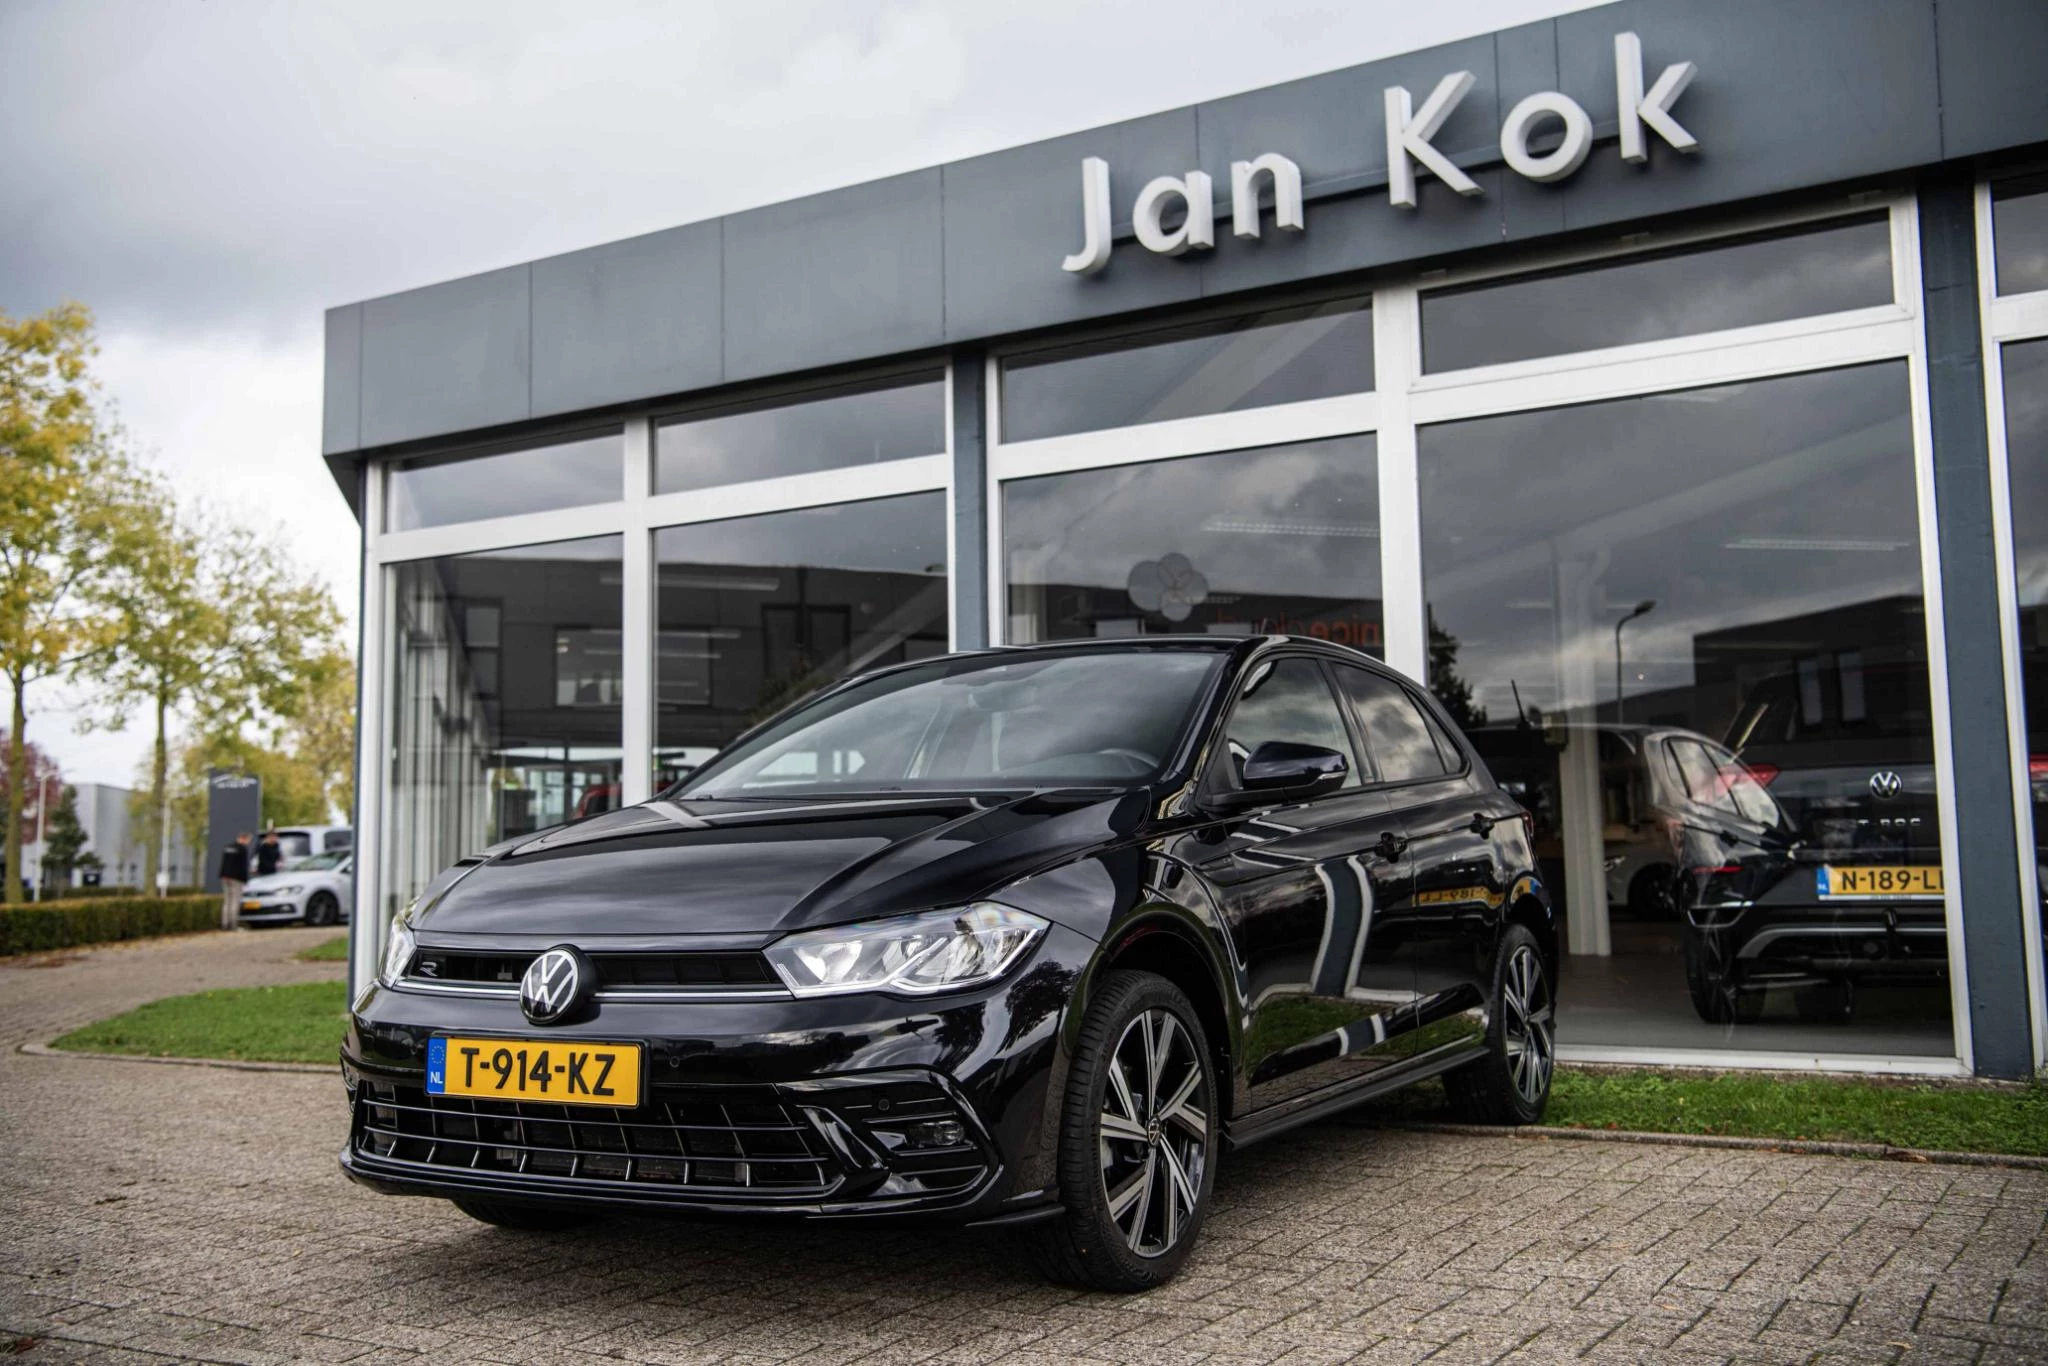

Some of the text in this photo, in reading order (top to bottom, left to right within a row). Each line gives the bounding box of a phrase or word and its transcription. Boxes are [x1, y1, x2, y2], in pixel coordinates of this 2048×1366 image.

[1062, 31, 1698, 275] Jan Kok
[429, 1071, 443, 1084] NL
[461, 1048, 616, 1096] T-914-KZ
